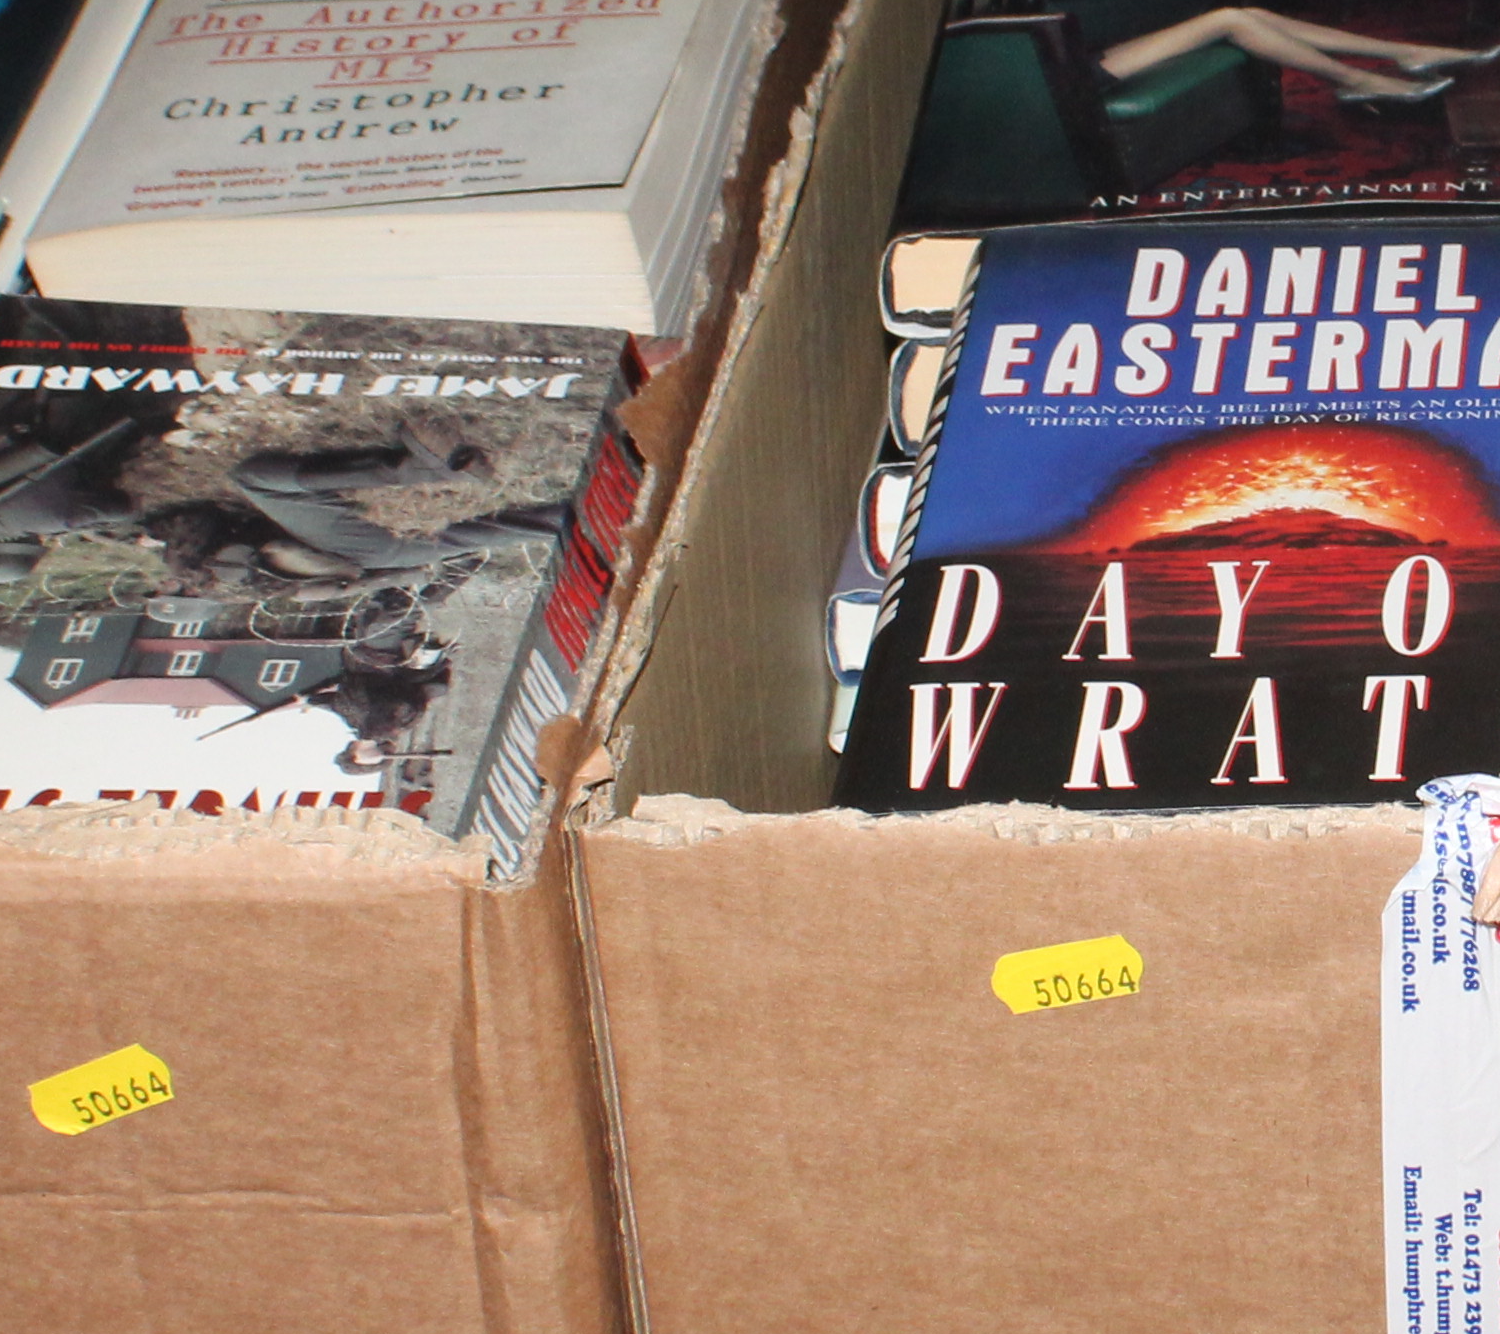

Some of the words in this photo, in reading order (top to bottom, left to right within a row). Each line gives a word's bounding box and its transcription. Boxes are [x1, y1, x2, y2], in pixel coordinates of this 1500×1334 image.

[170, 11, 265, 36] The
[219, 28, 469, 58] History
[511, 17, 585, 43] of
[329, 54, 435, 83] MI5
[163, 82, 566, 121] Christopher
[240, 114, 460, 146] Andrew
[1090, 194, 1140, 208] AN
[1159, 180, 1493, 205] ENTERTAINMENT
[1127, 243, 1481, 318] DANIEL
[364, 366, 584, 400] JAMES
[985, 404, 1062, 415] WHEN
[1068, 403, 1210, 415] FANATICAL
[1221, 402, 1306, 413] BELIEF
[1312, 400, 1401, 412] MEETS
[1026, 416, 1110, 427] THERE
[1116, 415, 1206, 427] COMES
[1216, 414, 1265, 426] THE
[1273, 413, 1328, 425] DAY
[918, 555, 1271, 664] DAY
[1033, 965, 1136, 1007] 50664
[71, 1071, 169, 1124] 50664
[1403, 1165, 1422, 1234] Email:
[1463, 1189, 1483, 1227] Tel:
[1433, 1213, 1453, 1264] Web:
[1463, 1234, 1482, 1294] 01473
